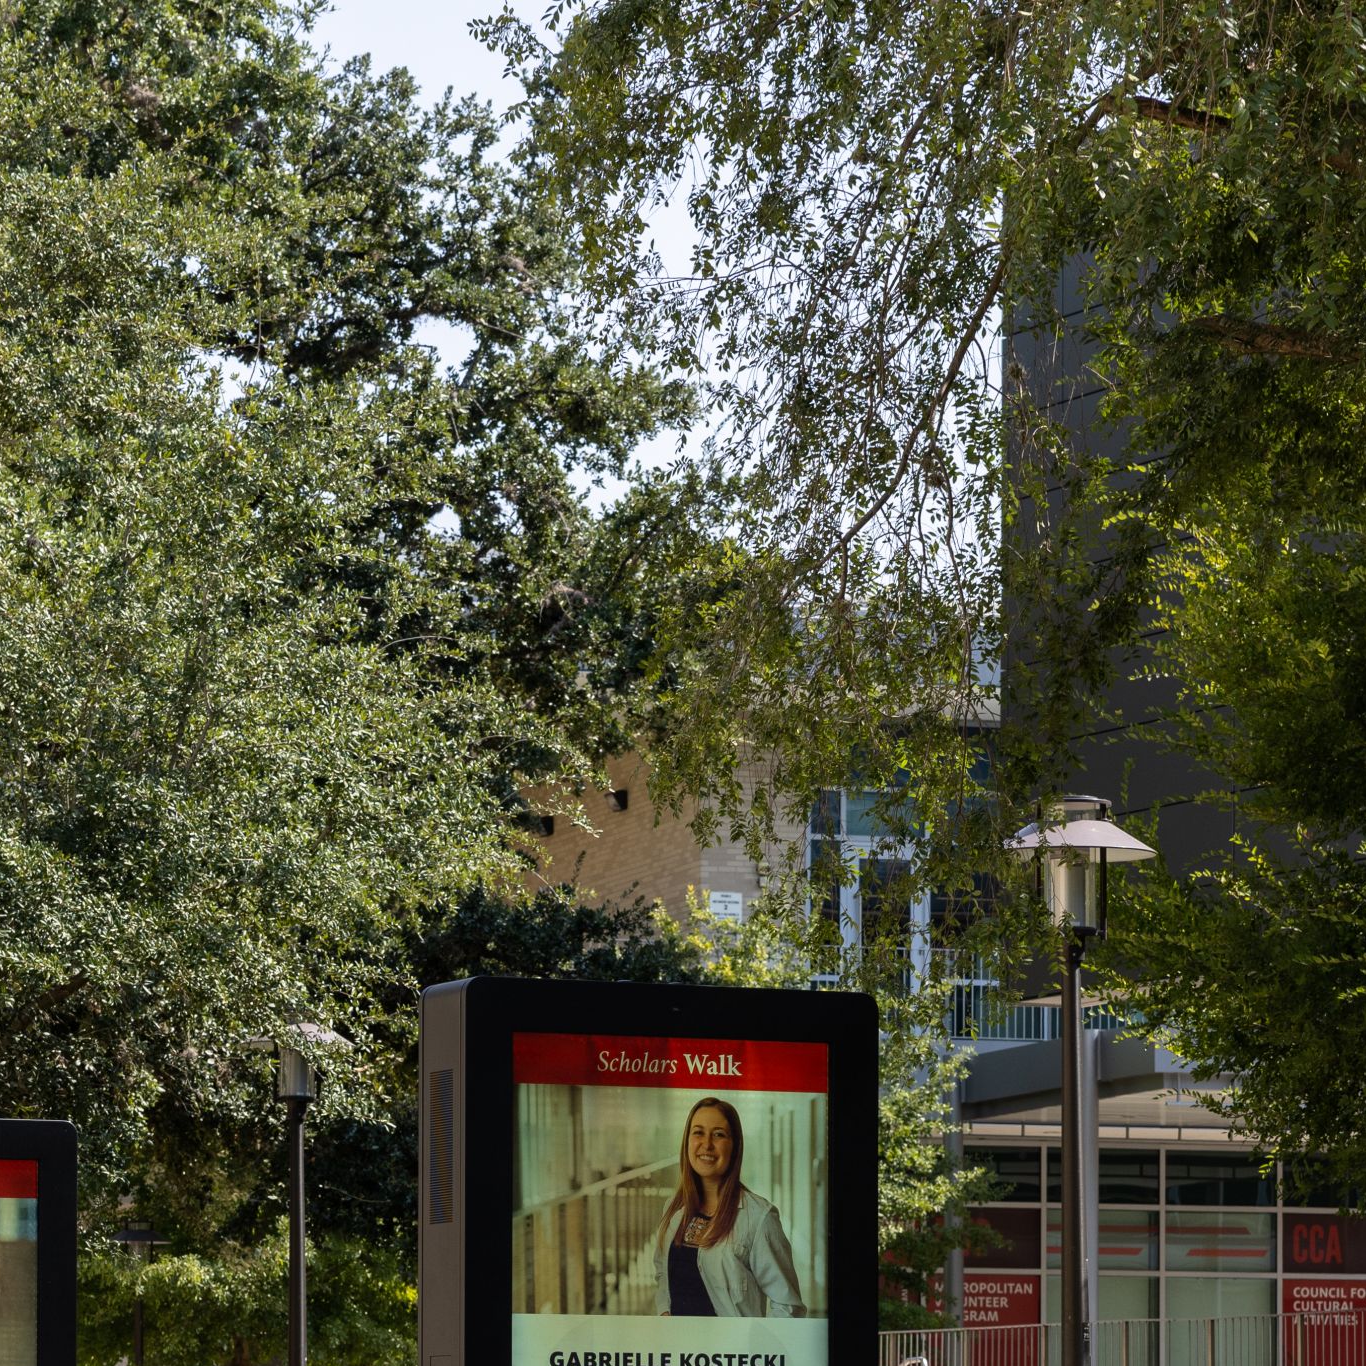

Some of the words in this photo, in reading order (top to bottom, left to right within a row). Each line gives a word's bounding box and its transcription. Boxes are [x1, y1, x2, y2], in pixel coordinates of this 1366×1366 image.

[597, 1050, 678, 1074] Scholars
[683, 1053, 743, 1076] Walk
[1292, 1224, 1343, 1264] CCA
[1293, 1287, 1348, 1298] COUNCIL
